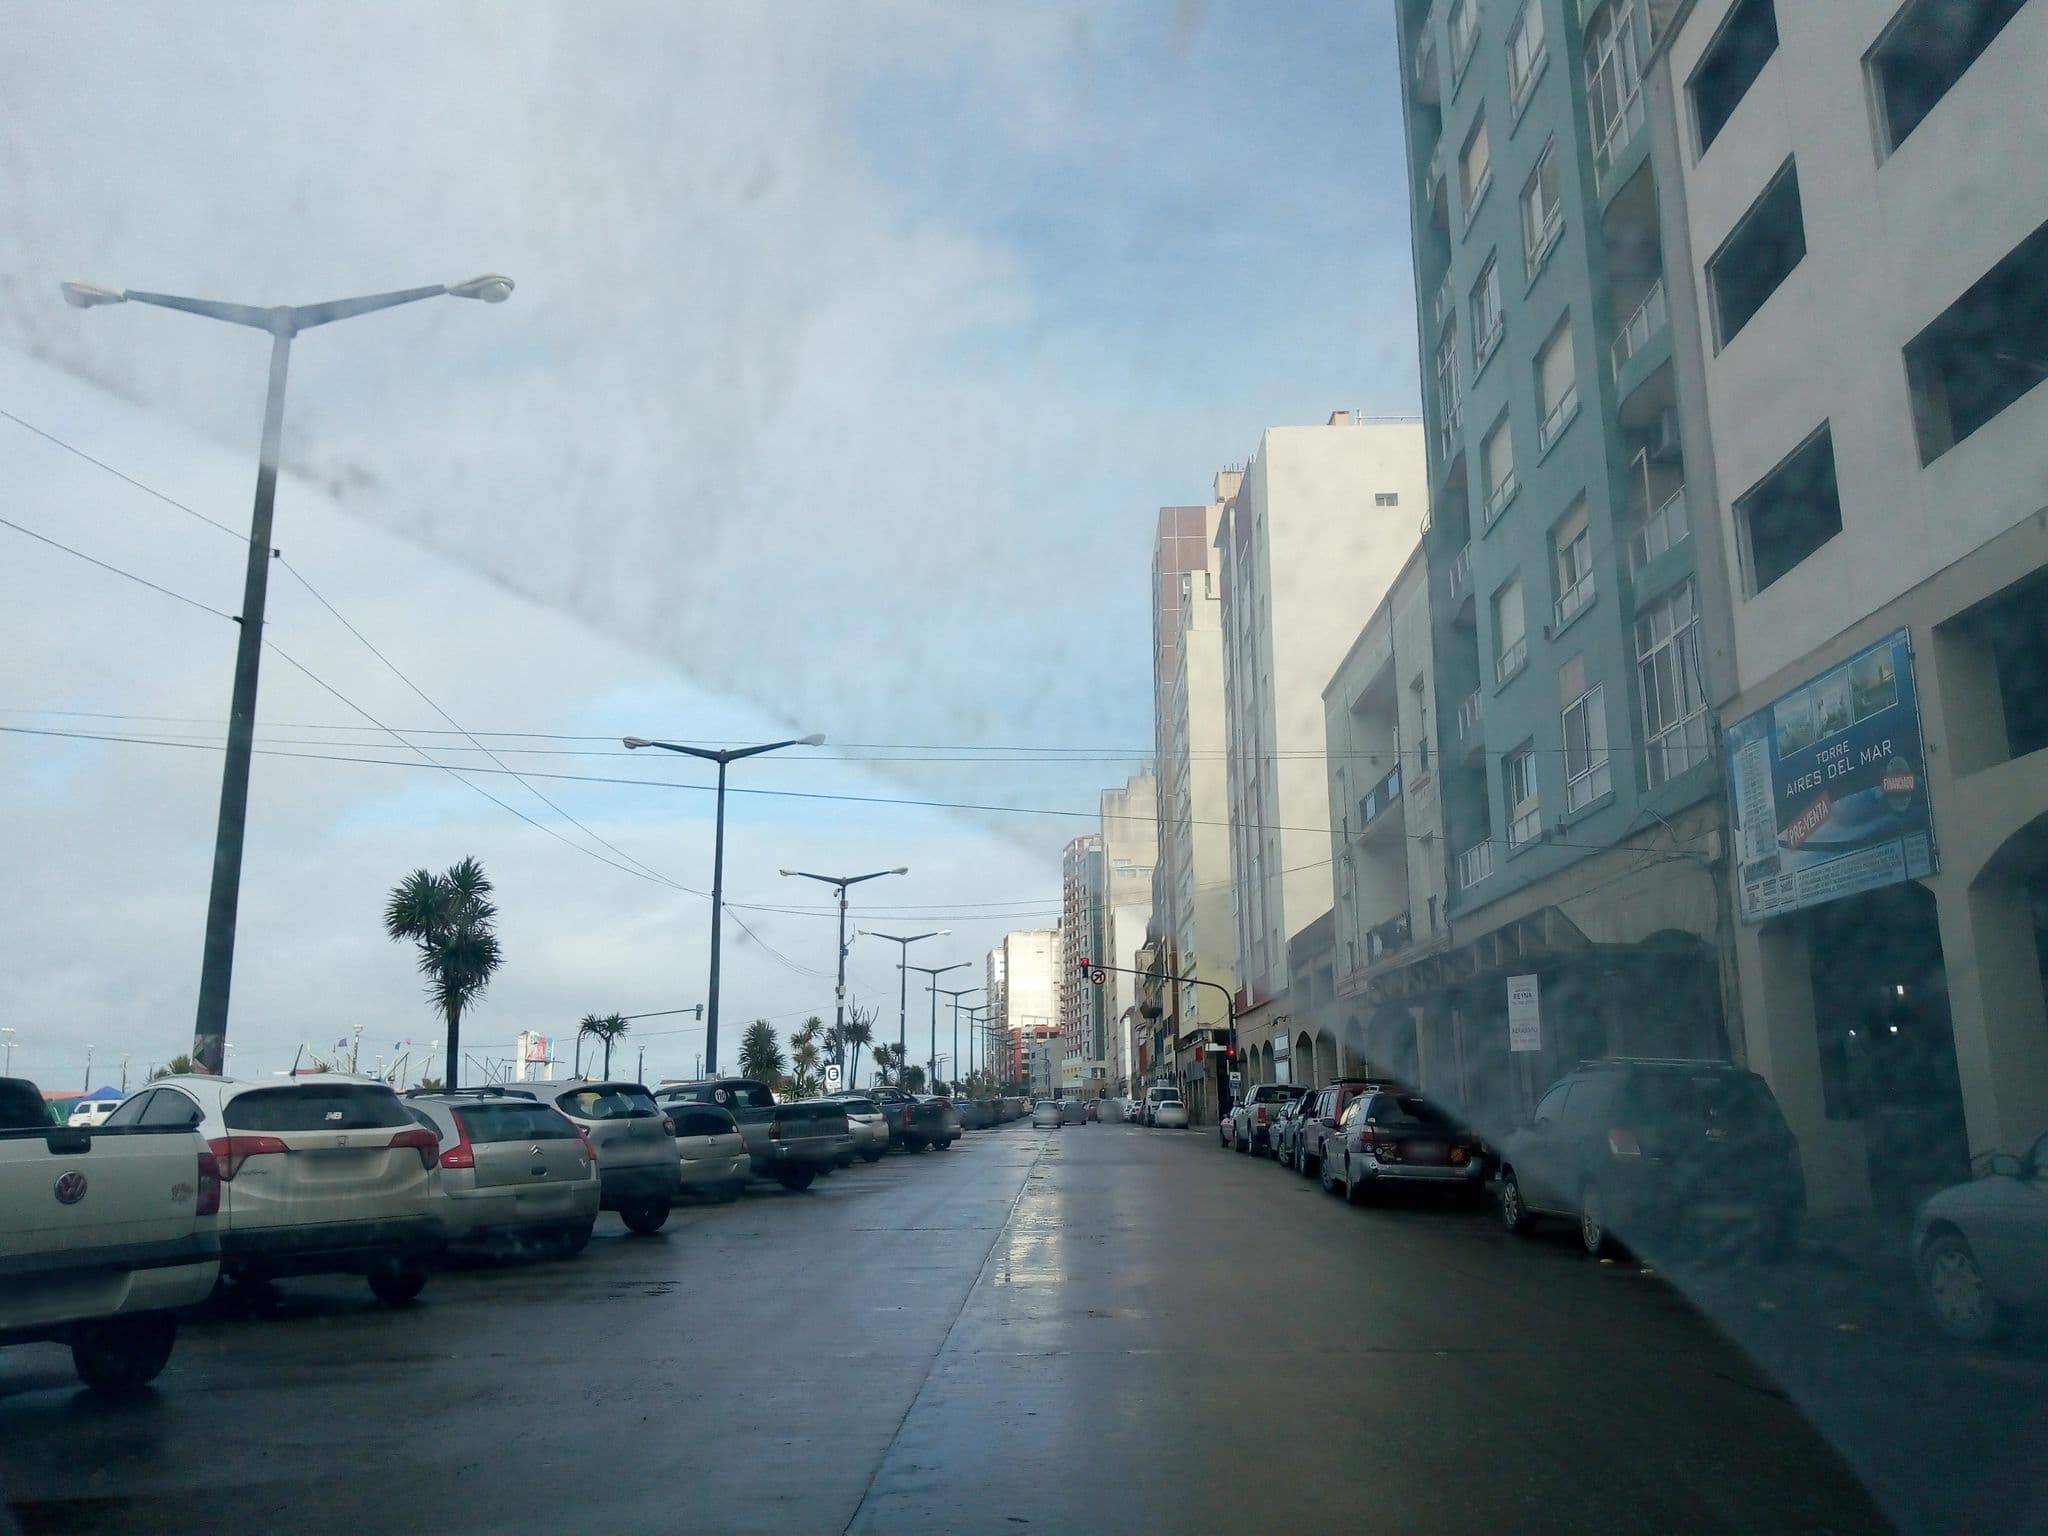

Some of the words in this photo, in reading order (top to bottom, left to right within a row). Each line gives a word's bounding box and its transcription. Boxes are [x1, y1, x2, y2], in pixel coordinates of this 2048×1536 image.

[1785, 770, 1822, 798] AIRES
[1828, 758, 1855, 779] DEL
[1860, 739, 1892, 766] MAR
[1815, 740, 1850, 764] TORRE
[1788, 800, 1829, 845] PRE-VENTA
